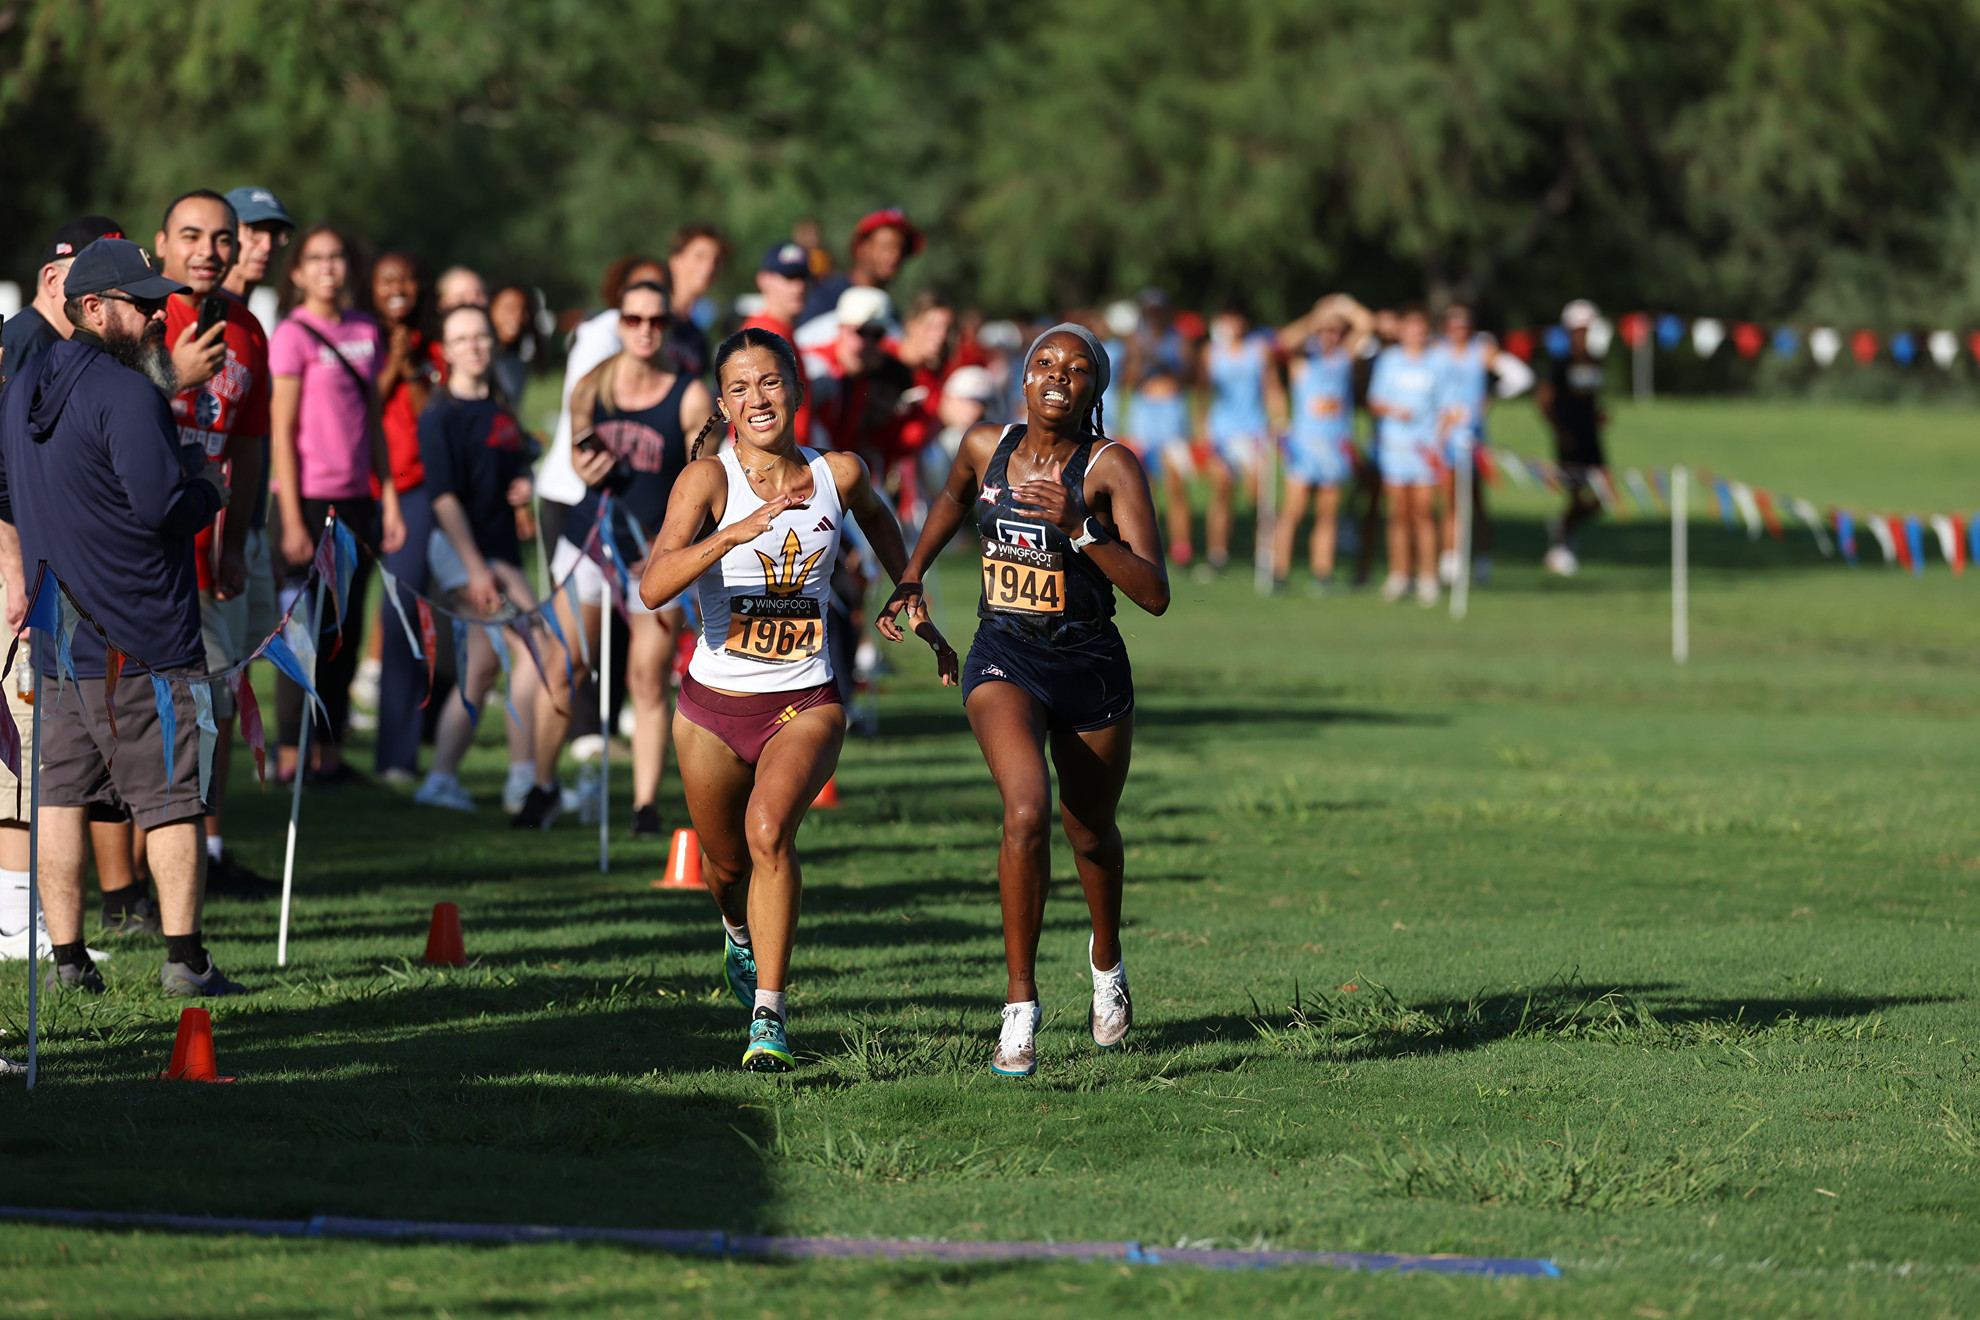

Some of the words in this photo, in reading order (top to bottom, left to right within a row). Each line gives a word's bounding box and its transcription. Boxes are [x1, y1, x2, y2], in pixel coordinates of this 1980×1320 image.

[998, 543, 1053, 563] WINGFOOT
[1000, 552, 1051, 568] FINISH
[984, 563, 1060, 608] 1944
[755, 599, 811, 610] WINGFOOT
[739, 617, 816, 657] 1964
